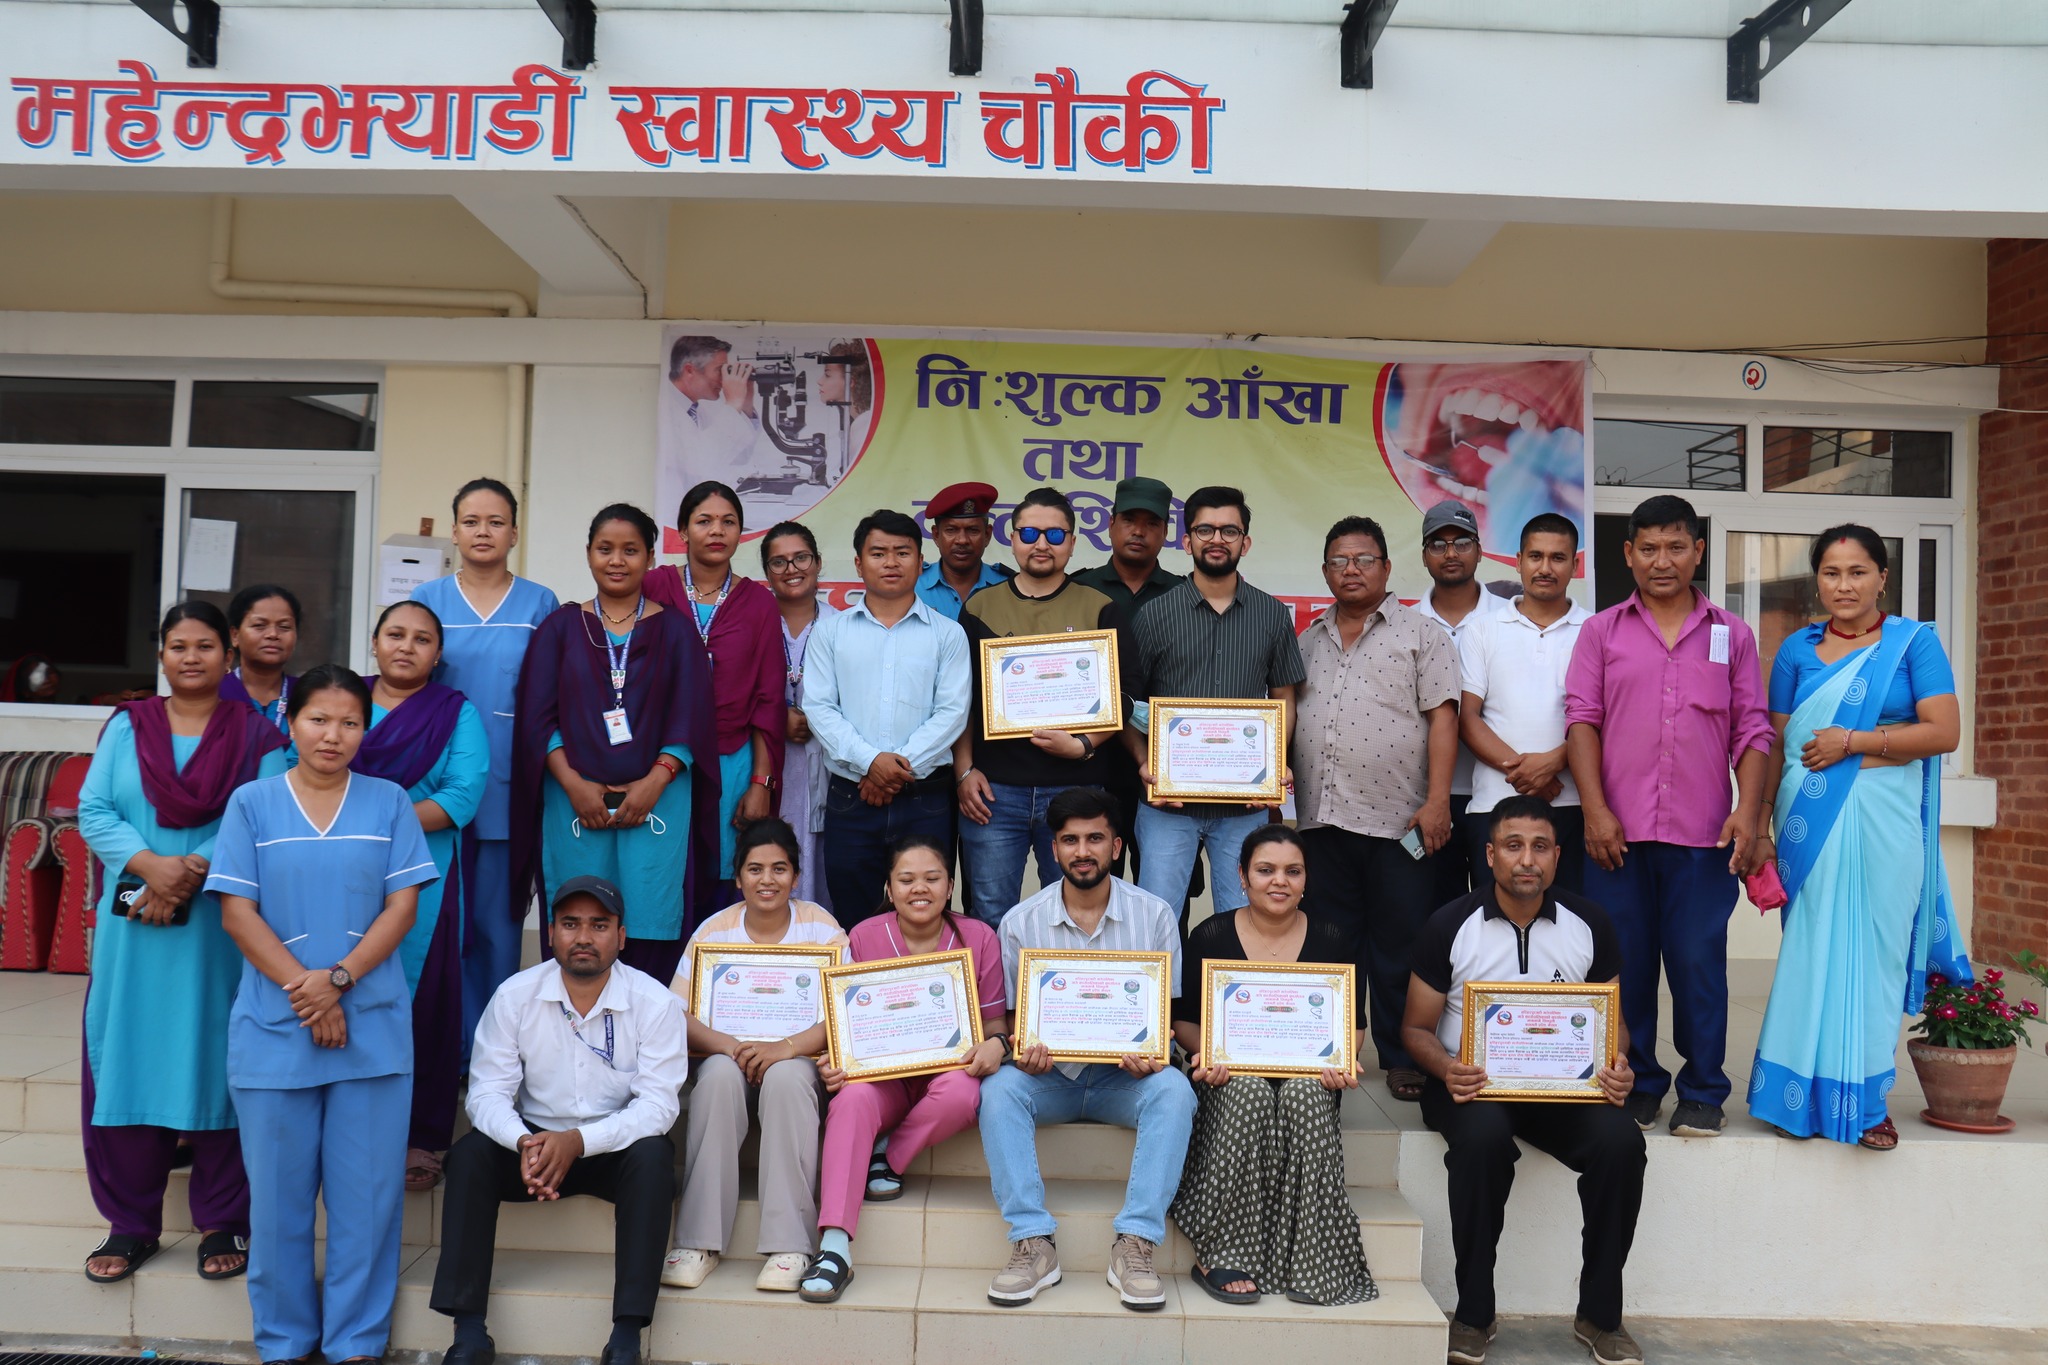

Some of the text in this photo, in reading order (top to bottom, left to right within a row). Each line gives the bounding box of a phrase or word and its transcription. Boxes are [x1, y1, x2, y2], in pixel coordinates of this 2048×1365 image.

[609, 86, 961, 172] स्वास्थ्य
[979, 67, 1226, 175] चौकी
[1186, 365, 1349, 425] आँखा
[1022, 438, 1143, 481] तथा
